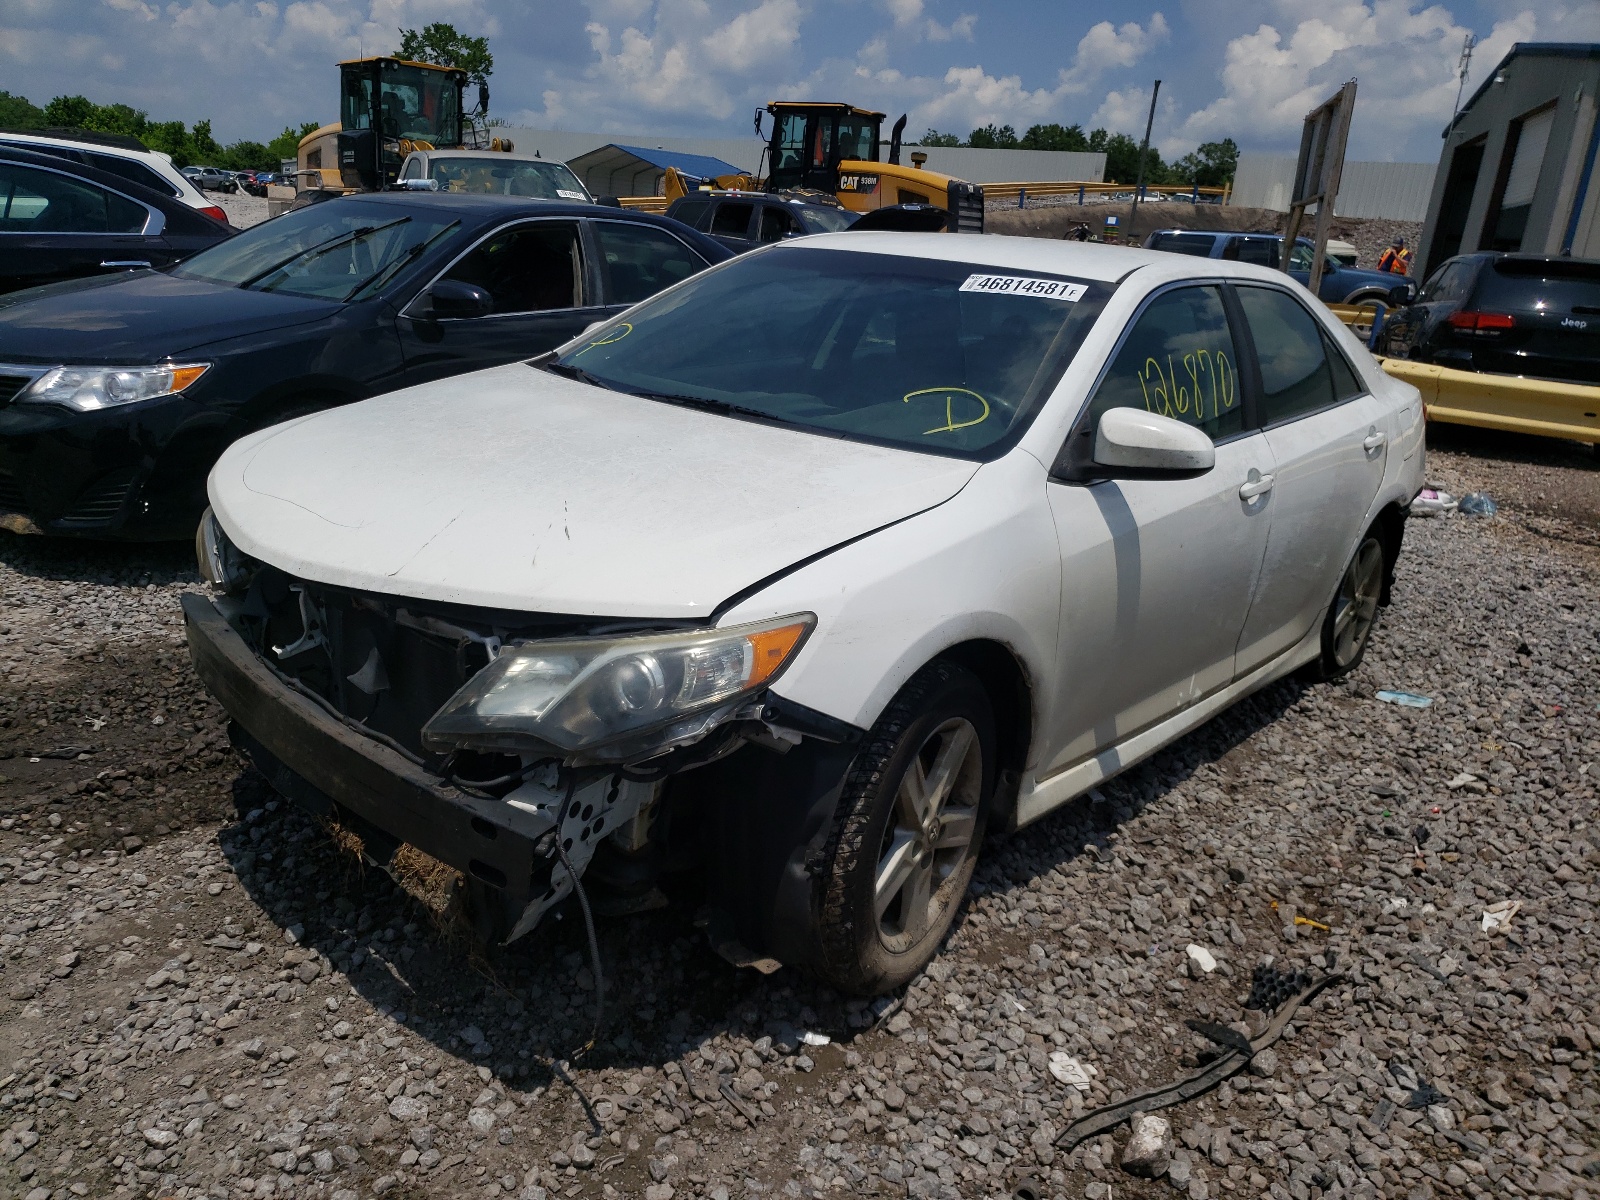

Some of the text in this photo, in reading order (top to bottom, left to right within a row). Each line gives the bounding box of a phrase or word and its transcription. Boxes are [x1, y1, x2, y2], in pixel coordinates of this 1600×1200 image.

[840, 175, 859, 190] CAT
[977, 277, 1070, 297] 46814581
[1560, 317, 1587, 329] Jeep
[1137, 349, 1234, 420] 126870
[903, 387, 990, 435] D
